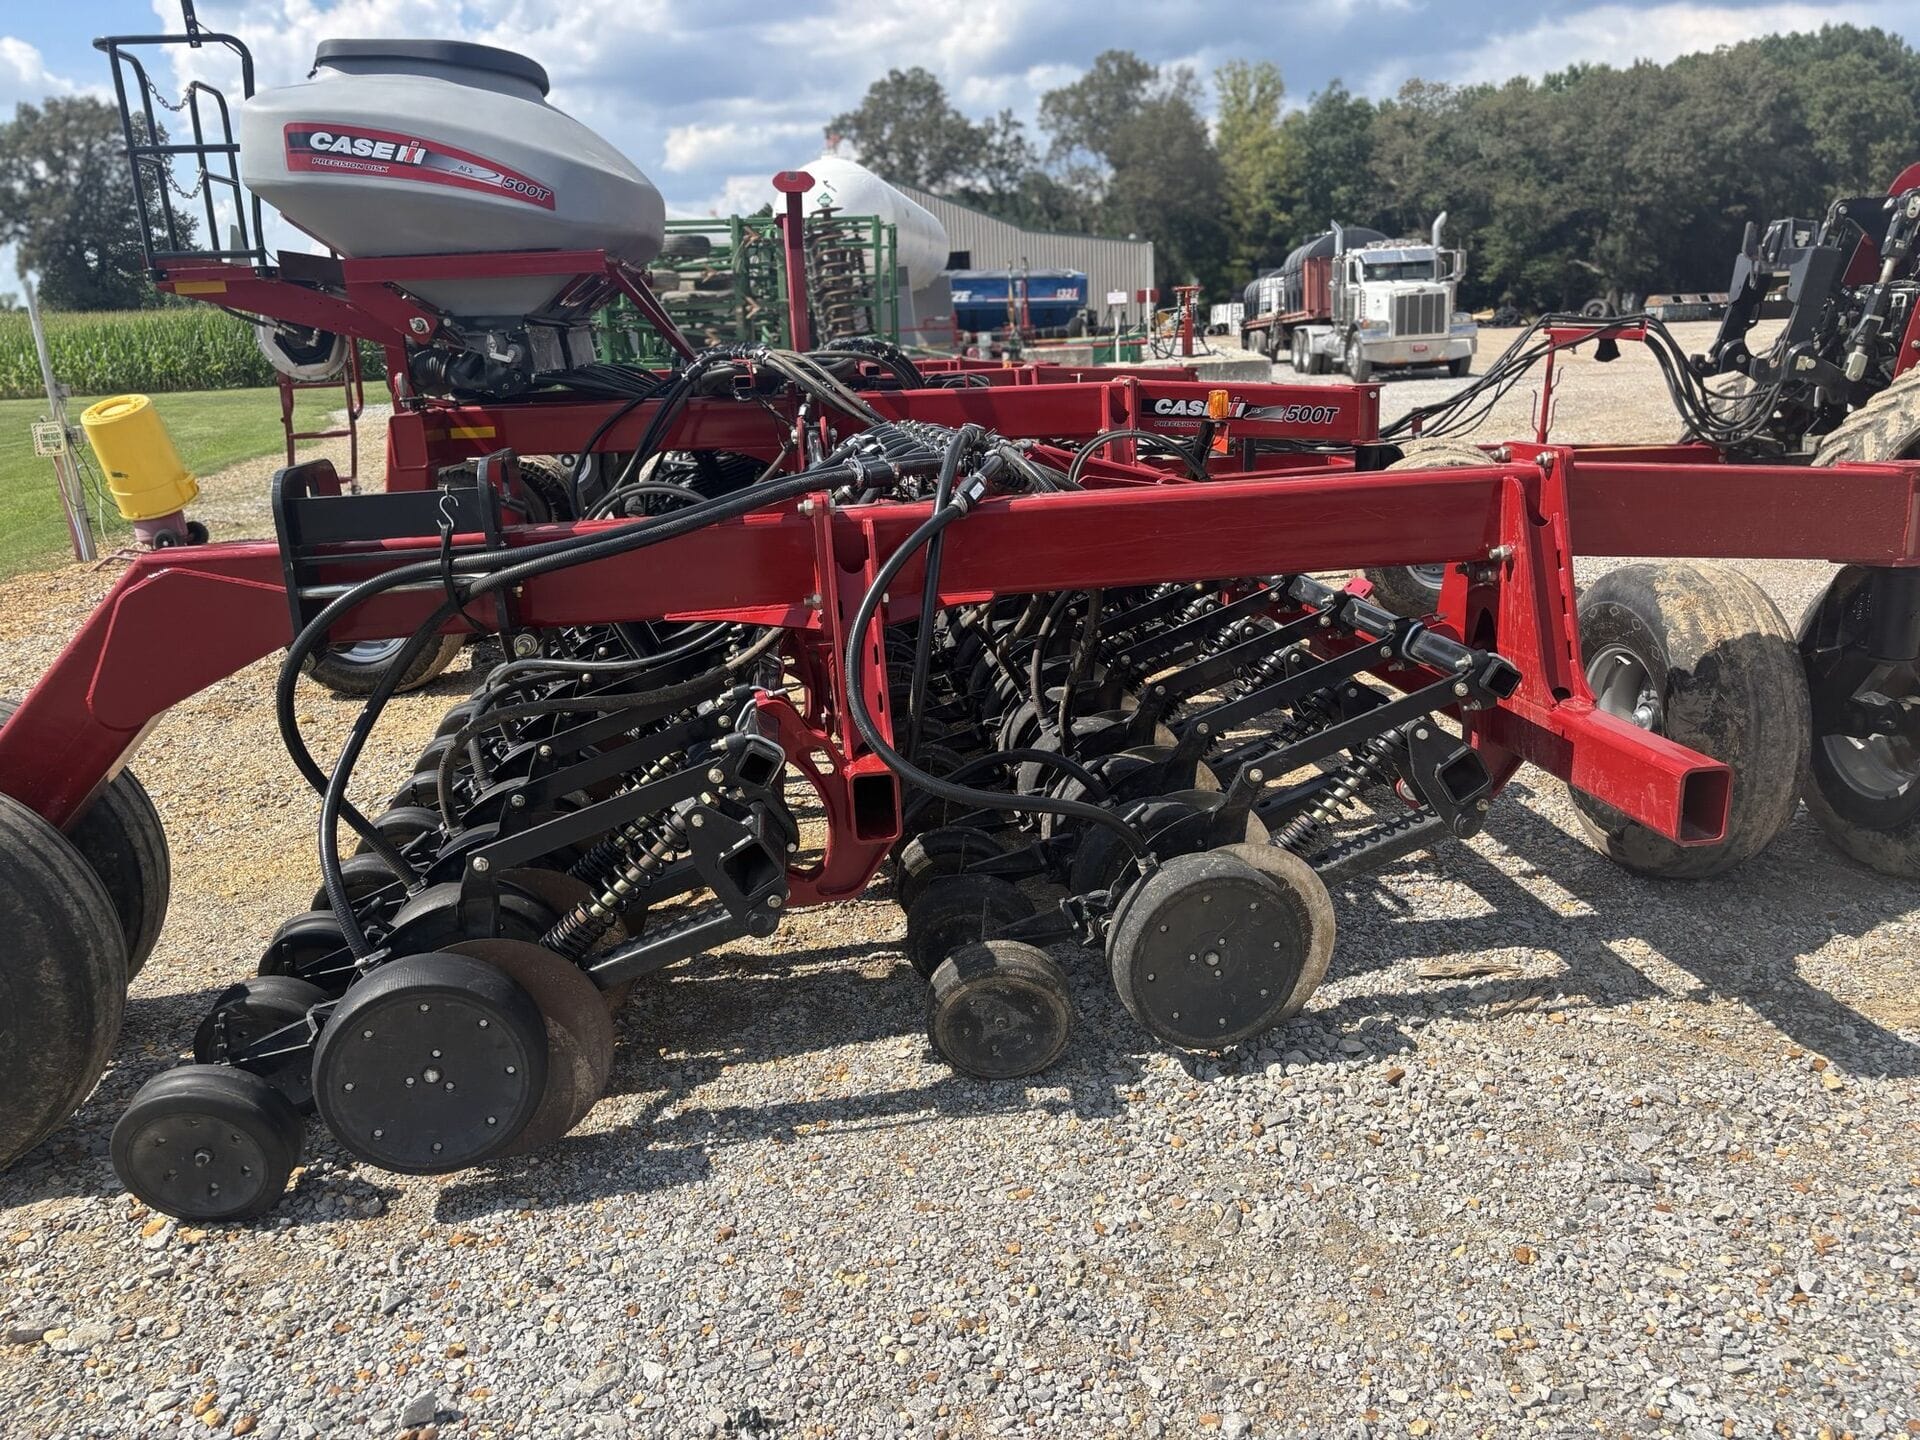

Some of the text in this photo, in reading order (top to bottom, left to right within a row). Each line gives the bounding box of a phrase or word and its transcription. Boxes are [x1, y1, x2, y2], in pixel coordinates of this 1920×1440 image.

[309, 131, 396, 160] CASE
[311, 157, 390, 173] PRECISION DISK
[502, 178, 551, 201] 500T
[1284, 404, 1340, 425] 500T
